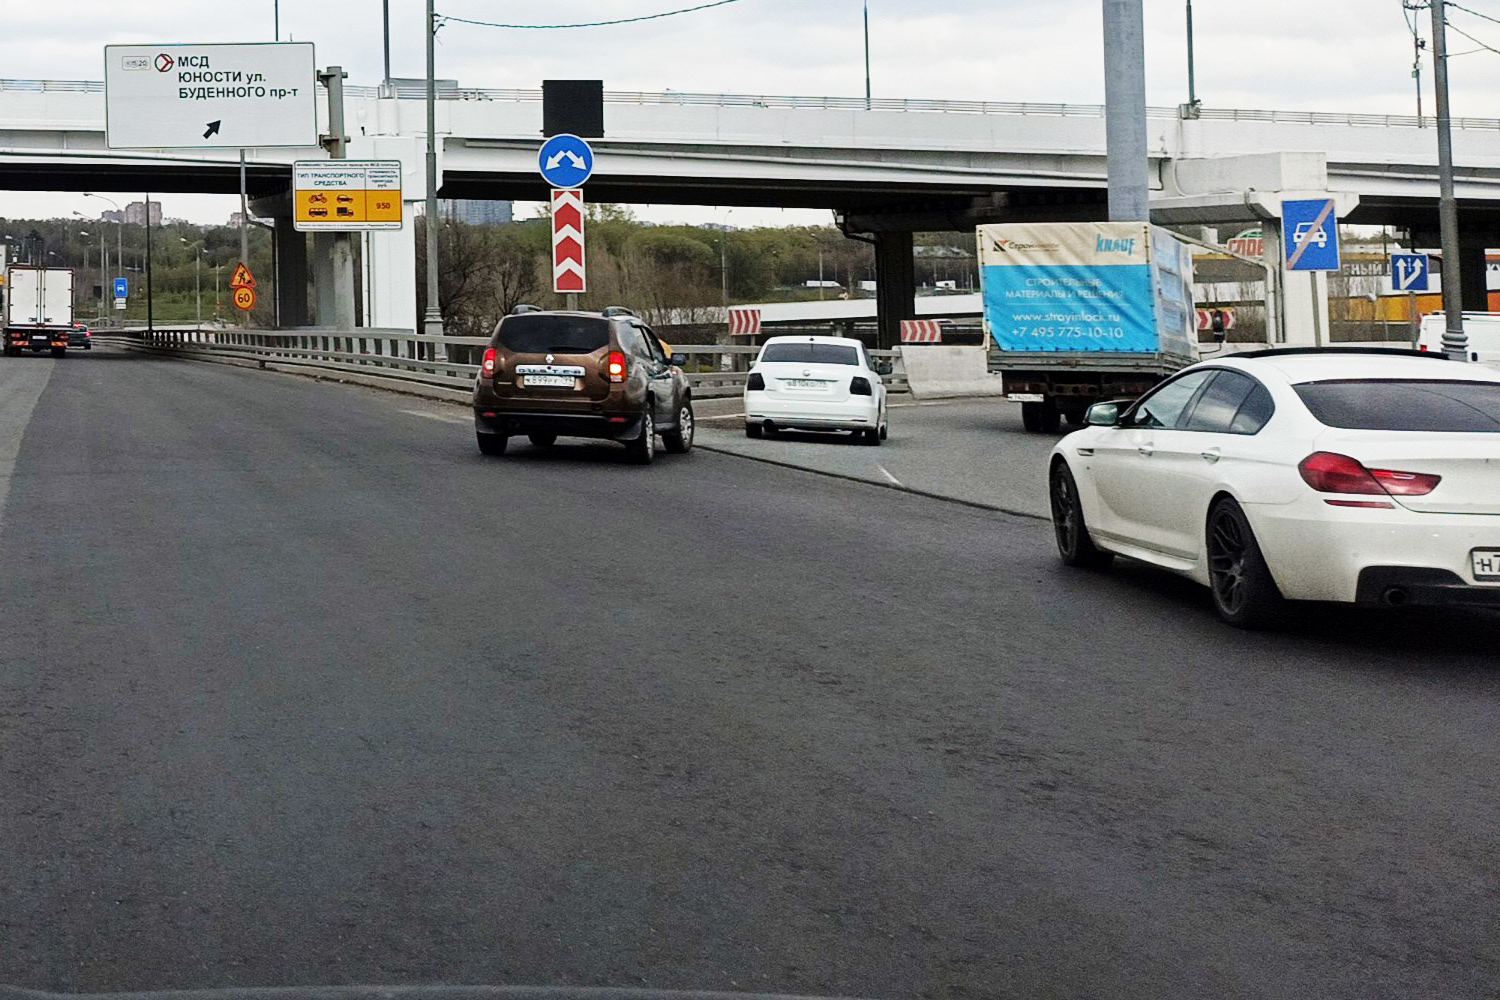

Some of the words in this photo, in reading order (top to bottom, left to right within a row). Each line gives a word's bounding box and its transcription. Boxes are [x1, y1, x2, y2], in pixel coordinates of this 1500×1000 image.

[177, 56, 210, 69] МСД
[178, 71, 242, 83] ЮНОСТИ
[246, 73, 267, 85] ул.
[179, 86, 266, 100] БУДЕННОГО
[269, 88, 299, 99] пр-т
[1096, 233, 1135, 256] KNAUF
[1025, 278, 1101, 287] СТРОИТЕЛЬНЫЕ
[237, 292, 250, 303] 60
[1005, 289, 1066, 299] МАТЕРИАЛЫ
[1077, 289, 1125, 299] РЕШЕНИЯ
[1012, 326, 1027, 338] +7
[1031, 326, 1056, 338] 495
[1058, 327, 1124, 339] 775-10-10
[518, 367, 581, 375] DUSTER
